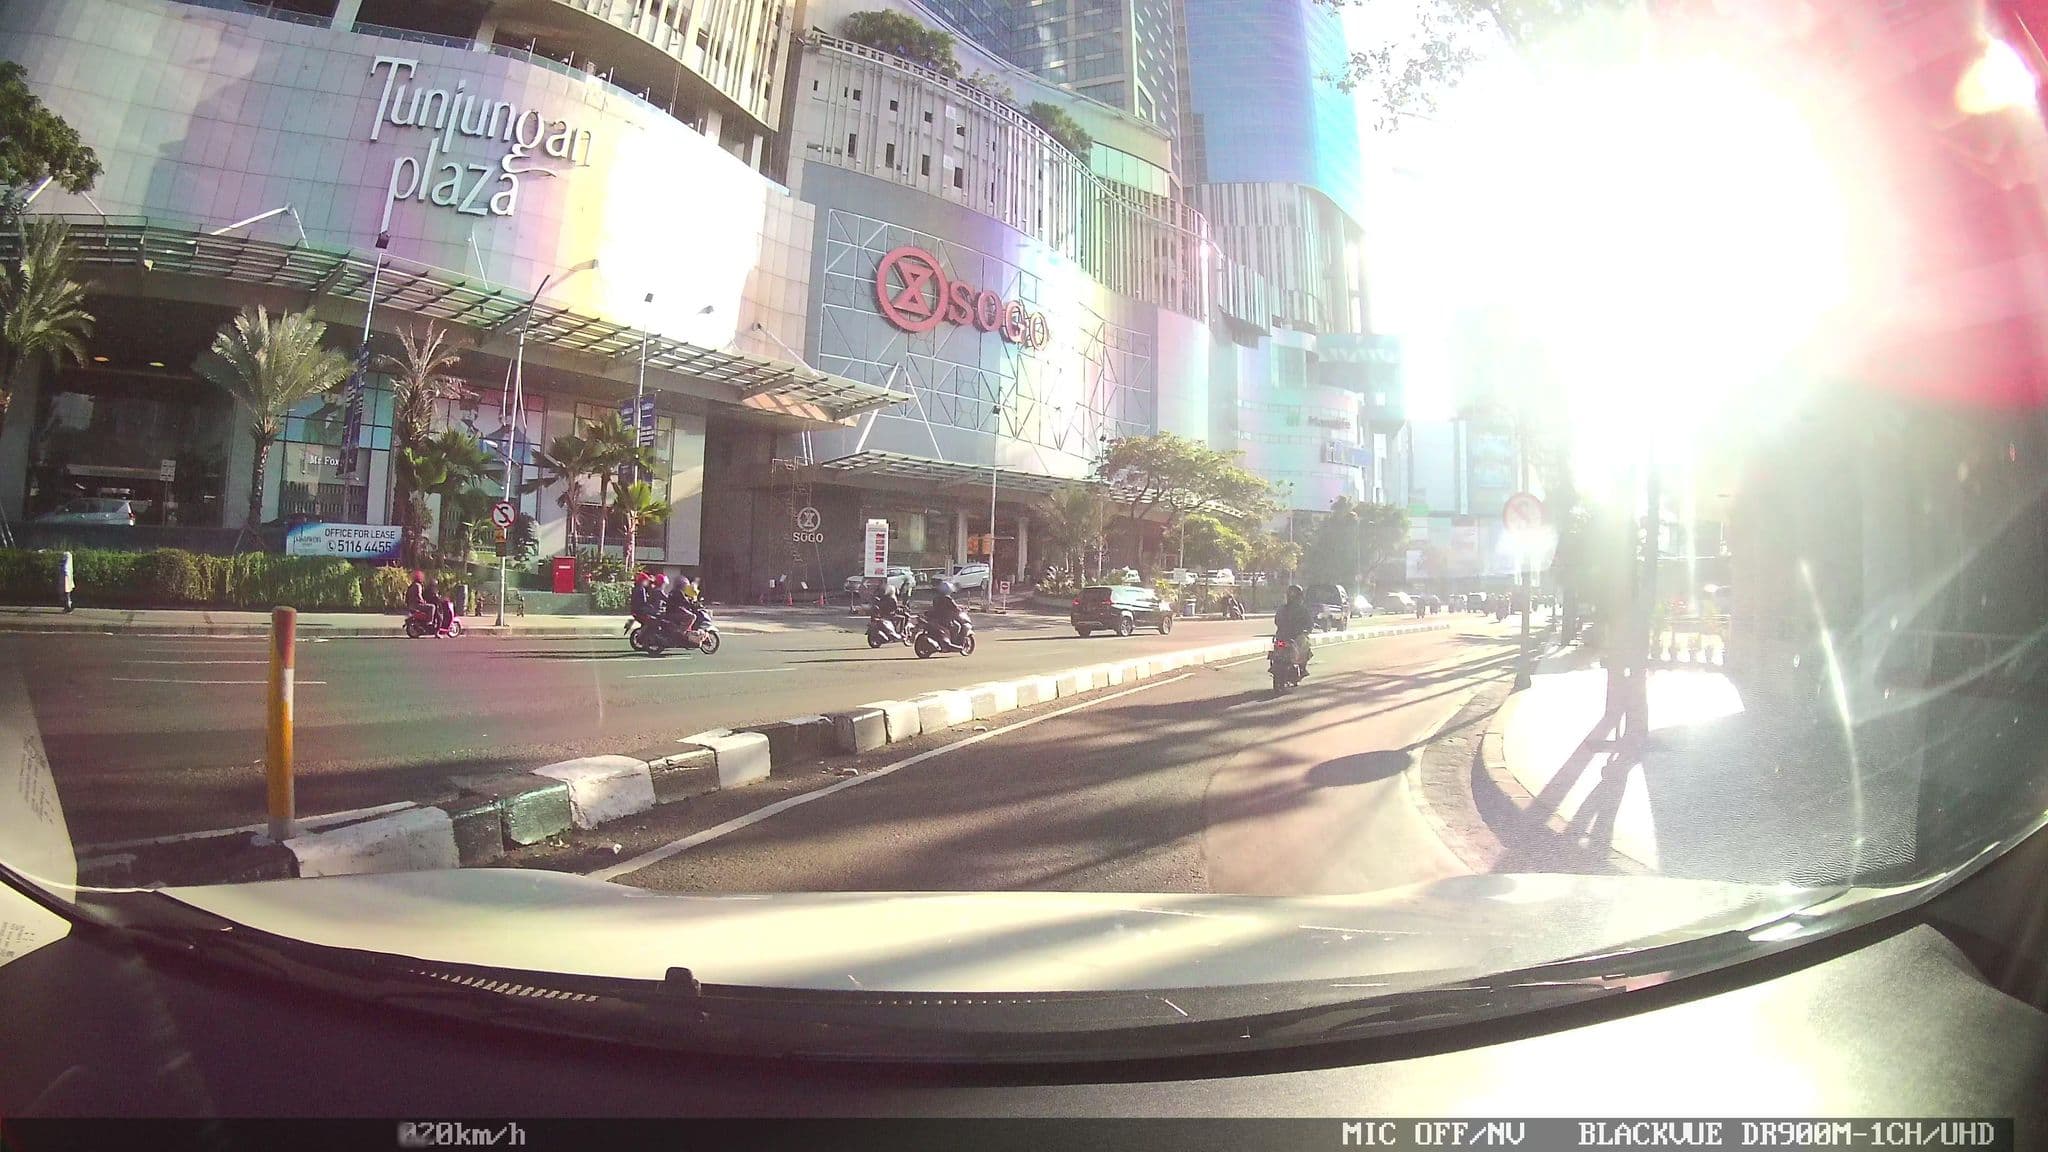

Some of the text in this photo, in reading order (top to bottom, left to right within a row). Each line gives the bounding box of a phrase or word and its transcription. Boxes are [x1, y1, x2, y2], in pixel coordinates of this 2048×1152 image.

[371, 55, 592, 178] Tunjungan
[380, 137, 520, 234] plaza
[948, 279, 1049, 351] SOGO
[324, 528, 352, 538] OFFICE
[353, 529, 370, 539] FOR
[370, 530, 396, 540] LEASE
[337, 540, 393, 553] 5116 4455
[792, 531, 824, 543] SOGO
